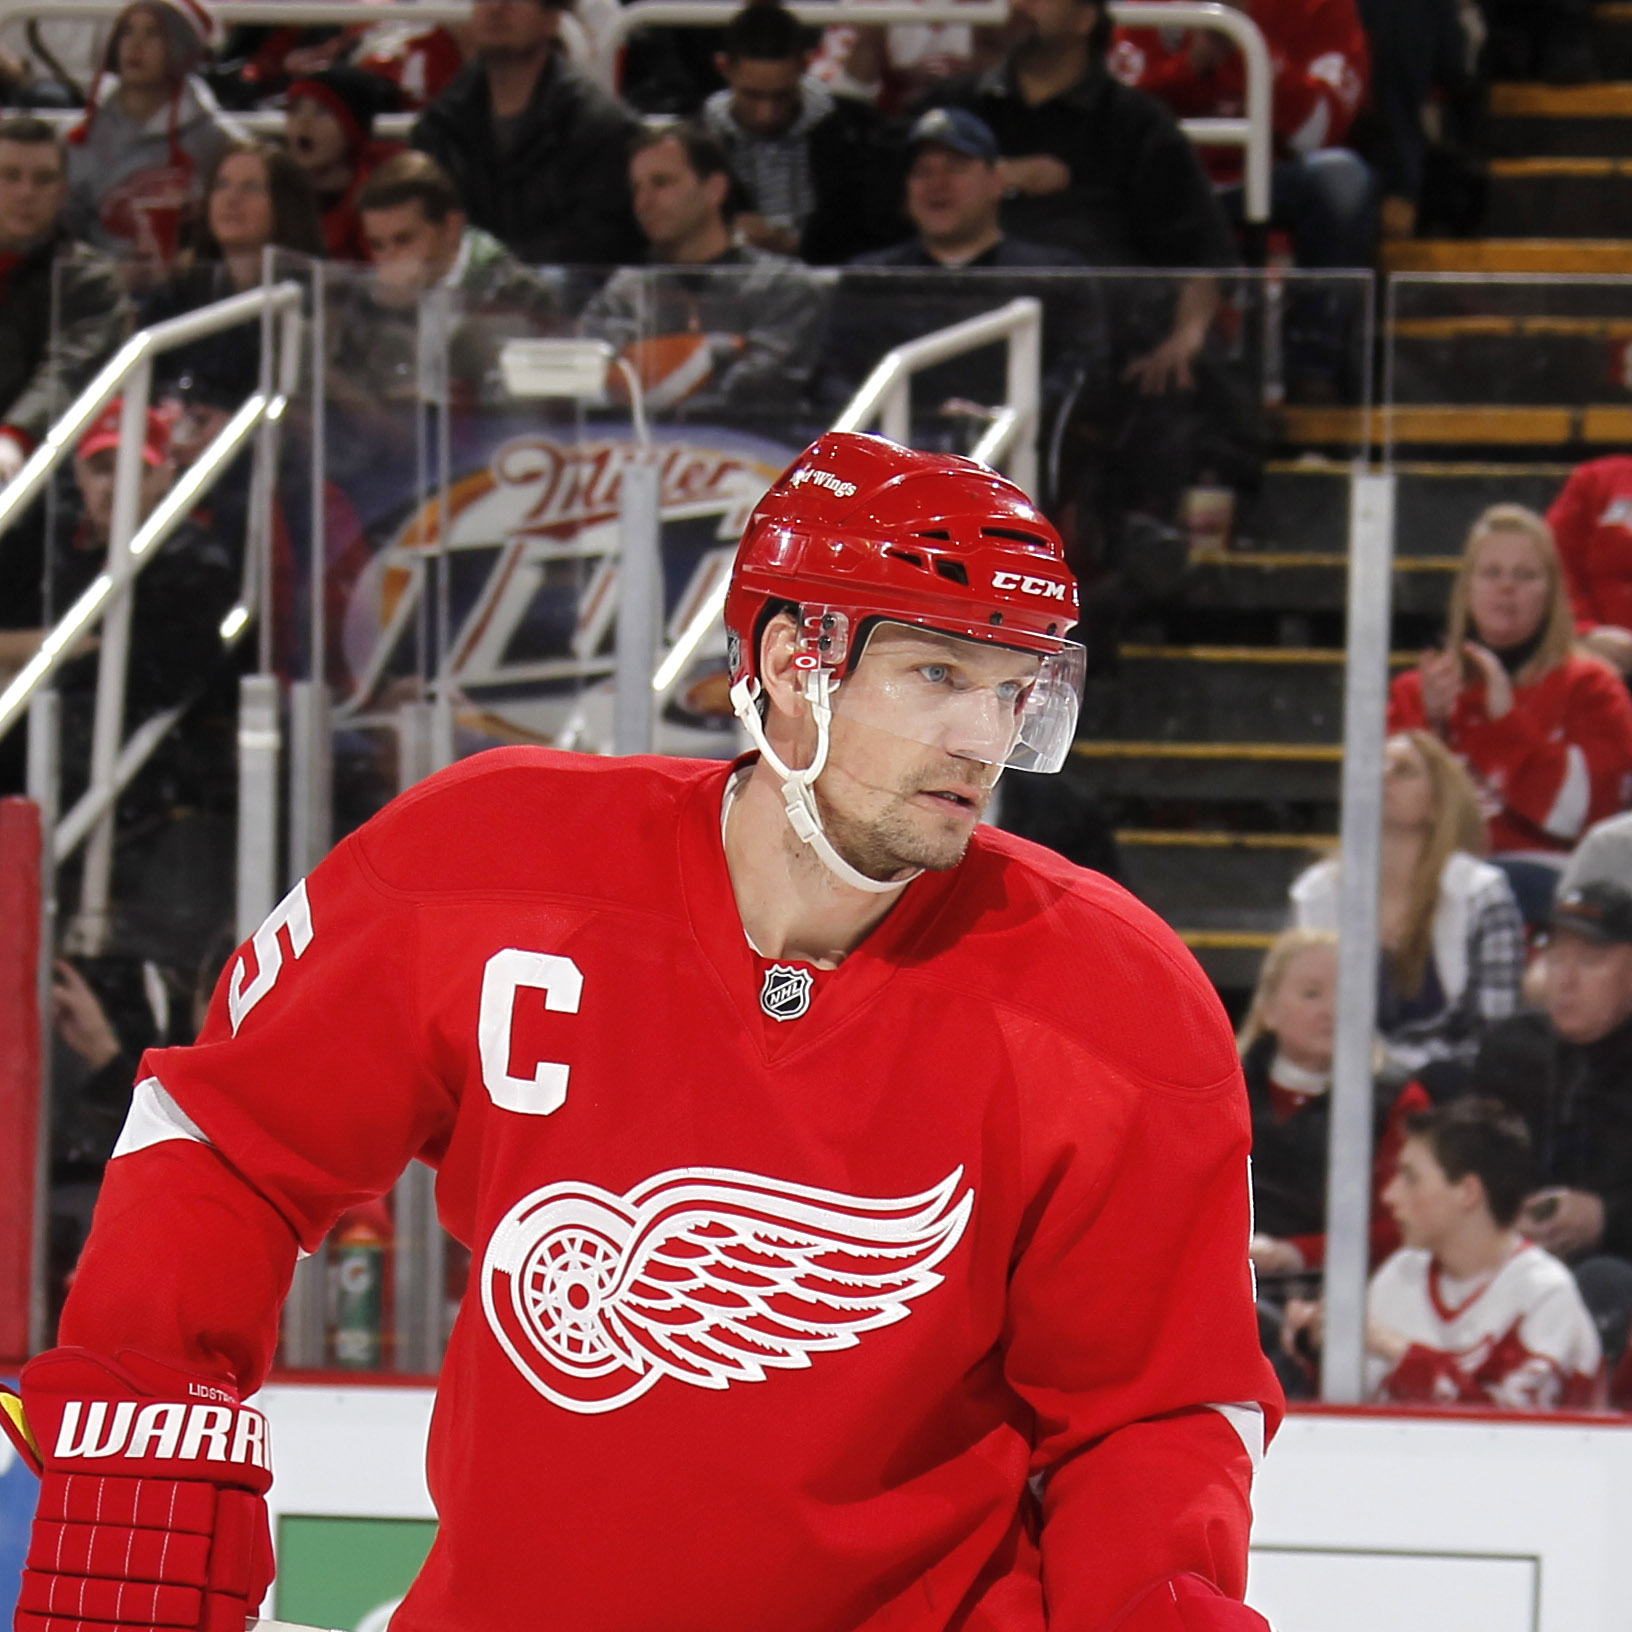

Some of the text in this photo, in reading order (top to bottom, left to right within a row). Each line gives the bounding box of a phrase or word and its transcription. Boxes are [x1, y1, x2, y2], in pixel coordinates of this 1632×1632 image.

[496, 438, 746, 521] Miler
[812, 470, 857, 498] Wings
[991, 570, 1067, 602] CCM
[769, 980, 802, 1006] NHL
[478, 948, 585, 1117] C
